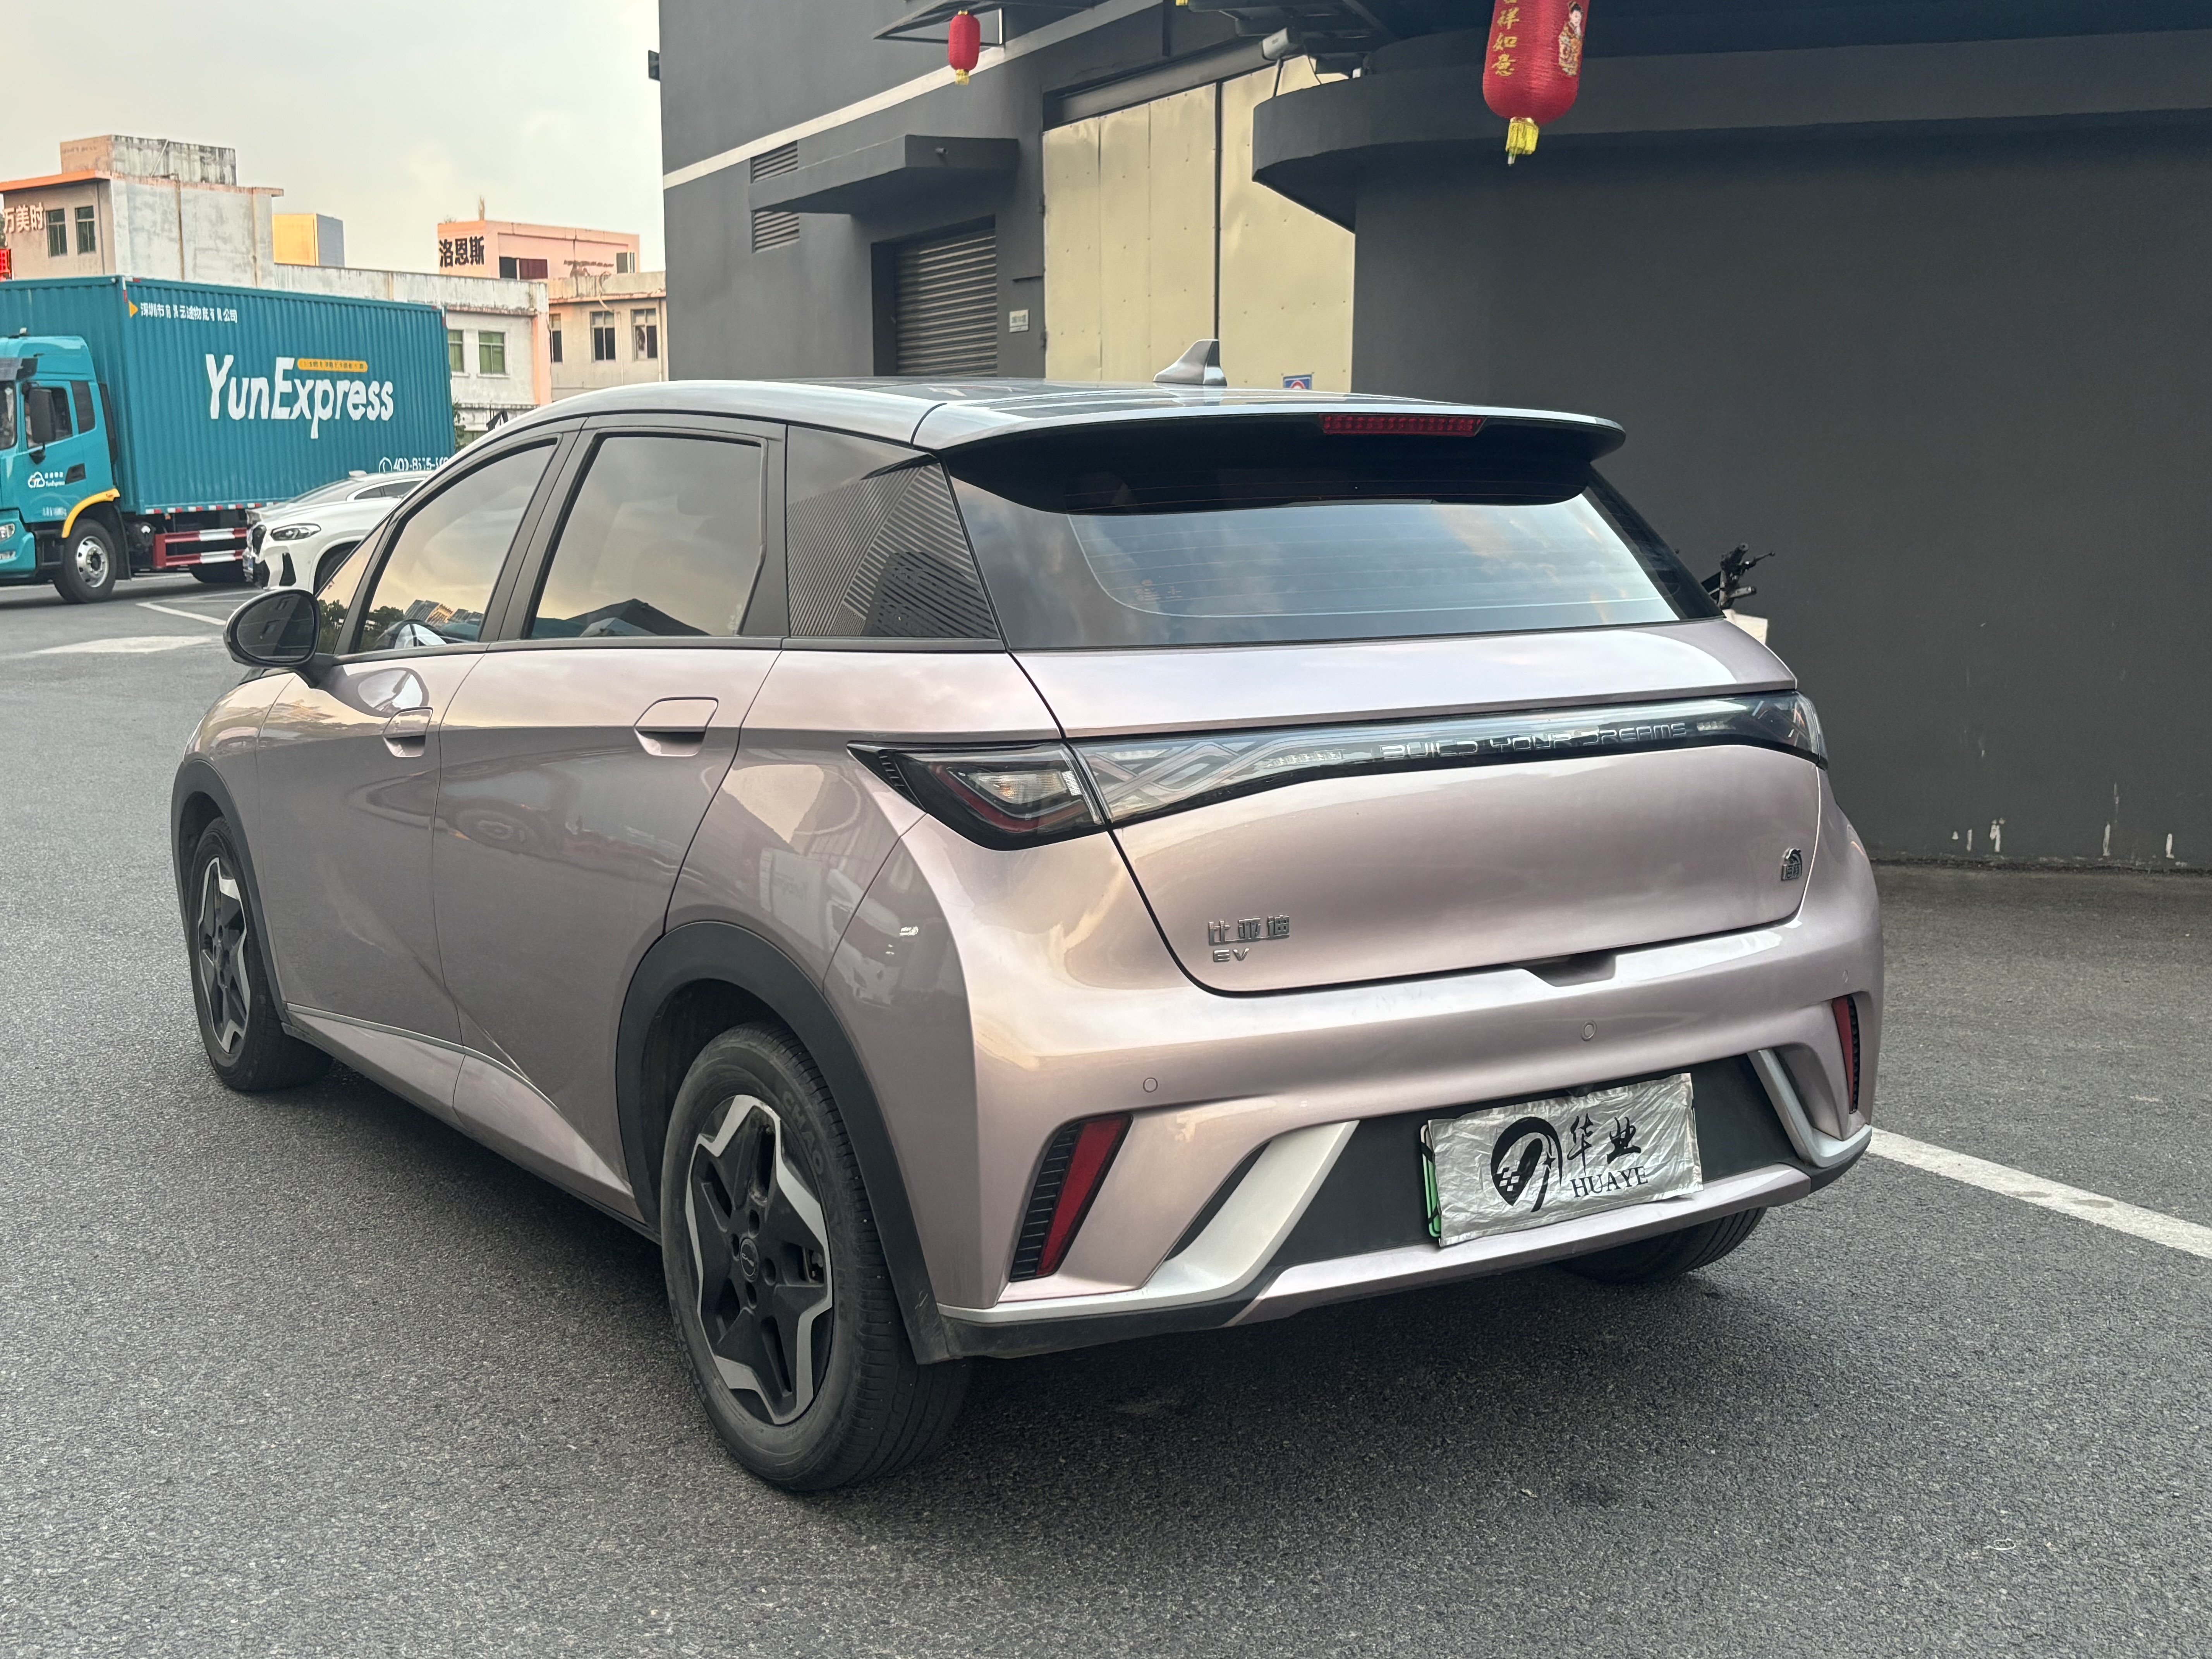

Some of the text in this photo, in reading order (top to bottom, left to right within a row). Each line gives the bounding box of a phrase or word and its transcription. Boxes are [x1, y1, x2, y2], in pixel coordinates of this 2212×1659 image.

[3, 202, 43, 233] 万美时
[439, 235, 484, 268] 洛恩斯
[206, 354, 393, 439] YunExpress
[1380, 723, 1687, 759] BUILD YOUR DREAMS
[1209, 915, 1290, 946] 比亚迪
[1213, 948, 1250, 962] EV
[782, 1091, 824, 1176] CHAO
[1567, 1112, 1642, 1176] 华业
[1570, 1166, 1649, 1198] HUAYE
